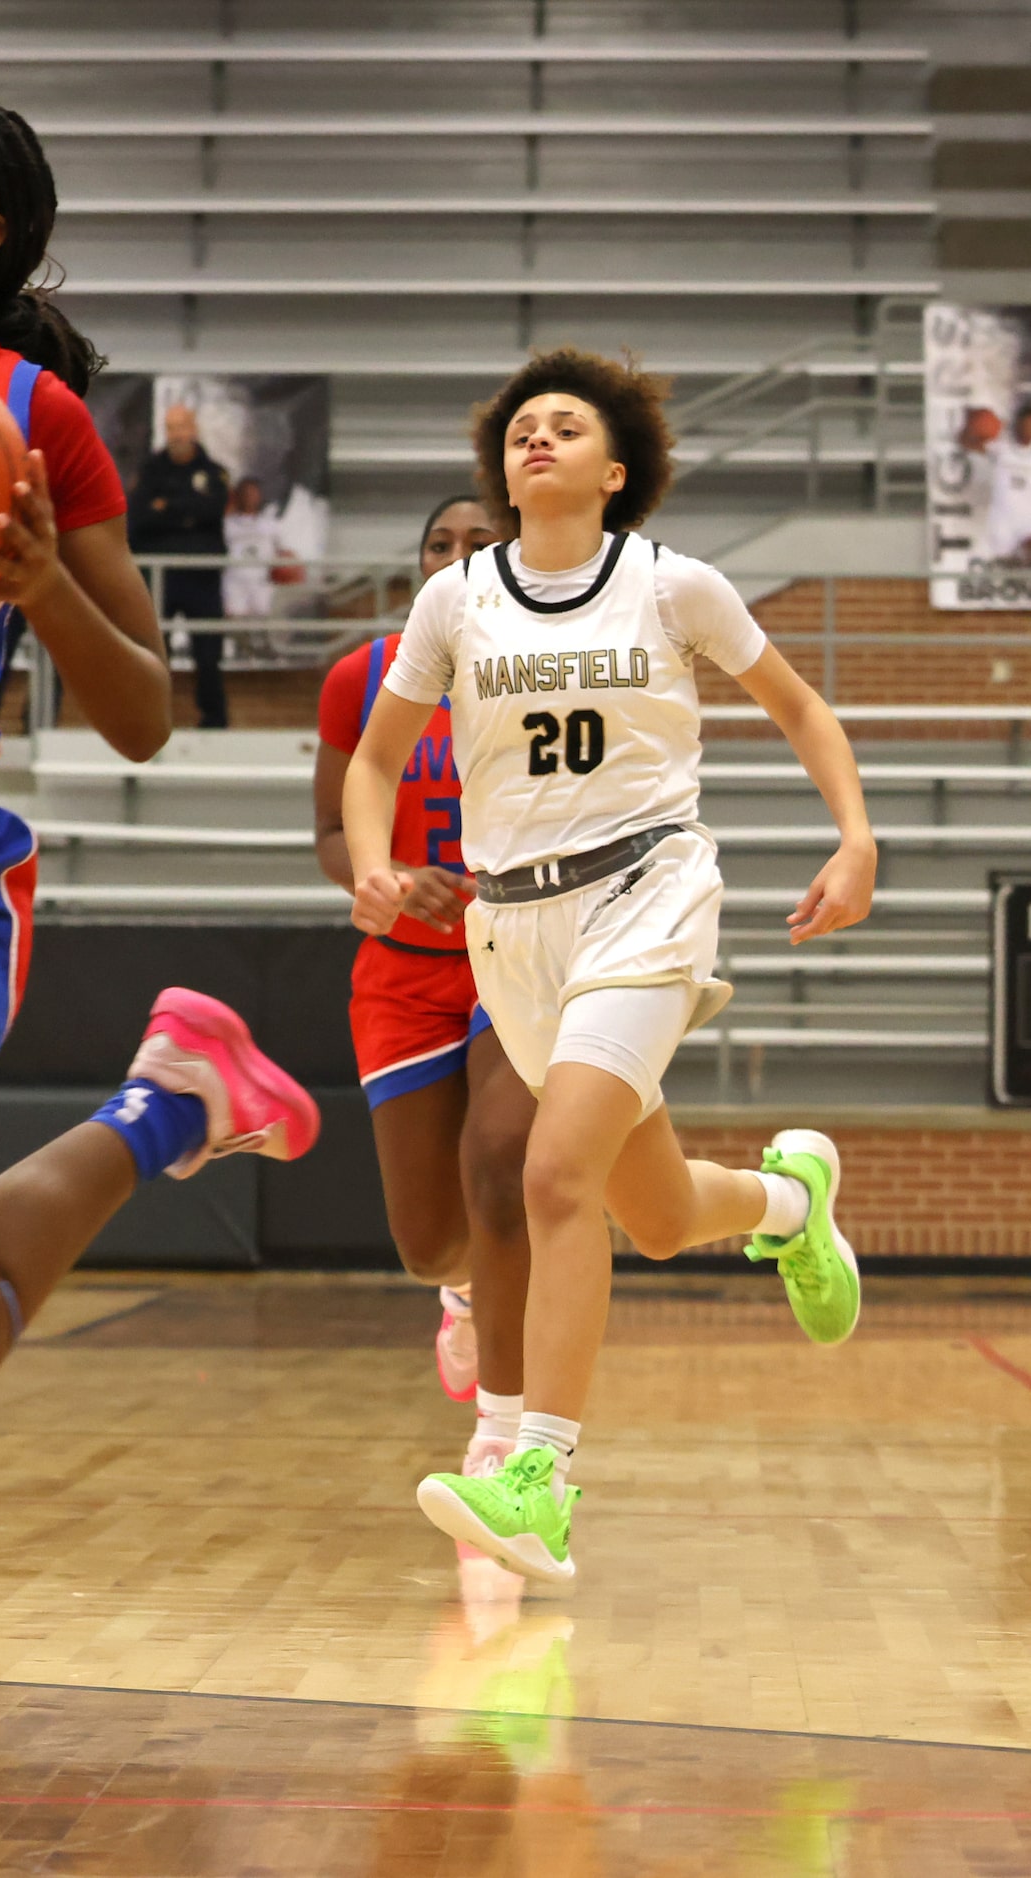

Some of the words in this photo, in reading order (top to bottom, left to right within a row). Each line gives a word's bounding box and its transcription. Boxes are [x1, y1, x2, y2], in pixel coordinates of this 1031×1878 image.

[474, 648, 649, 700] MANSFIELD
[522, 709, 604, 776] 20
[424, 798, 465, 876] 2
